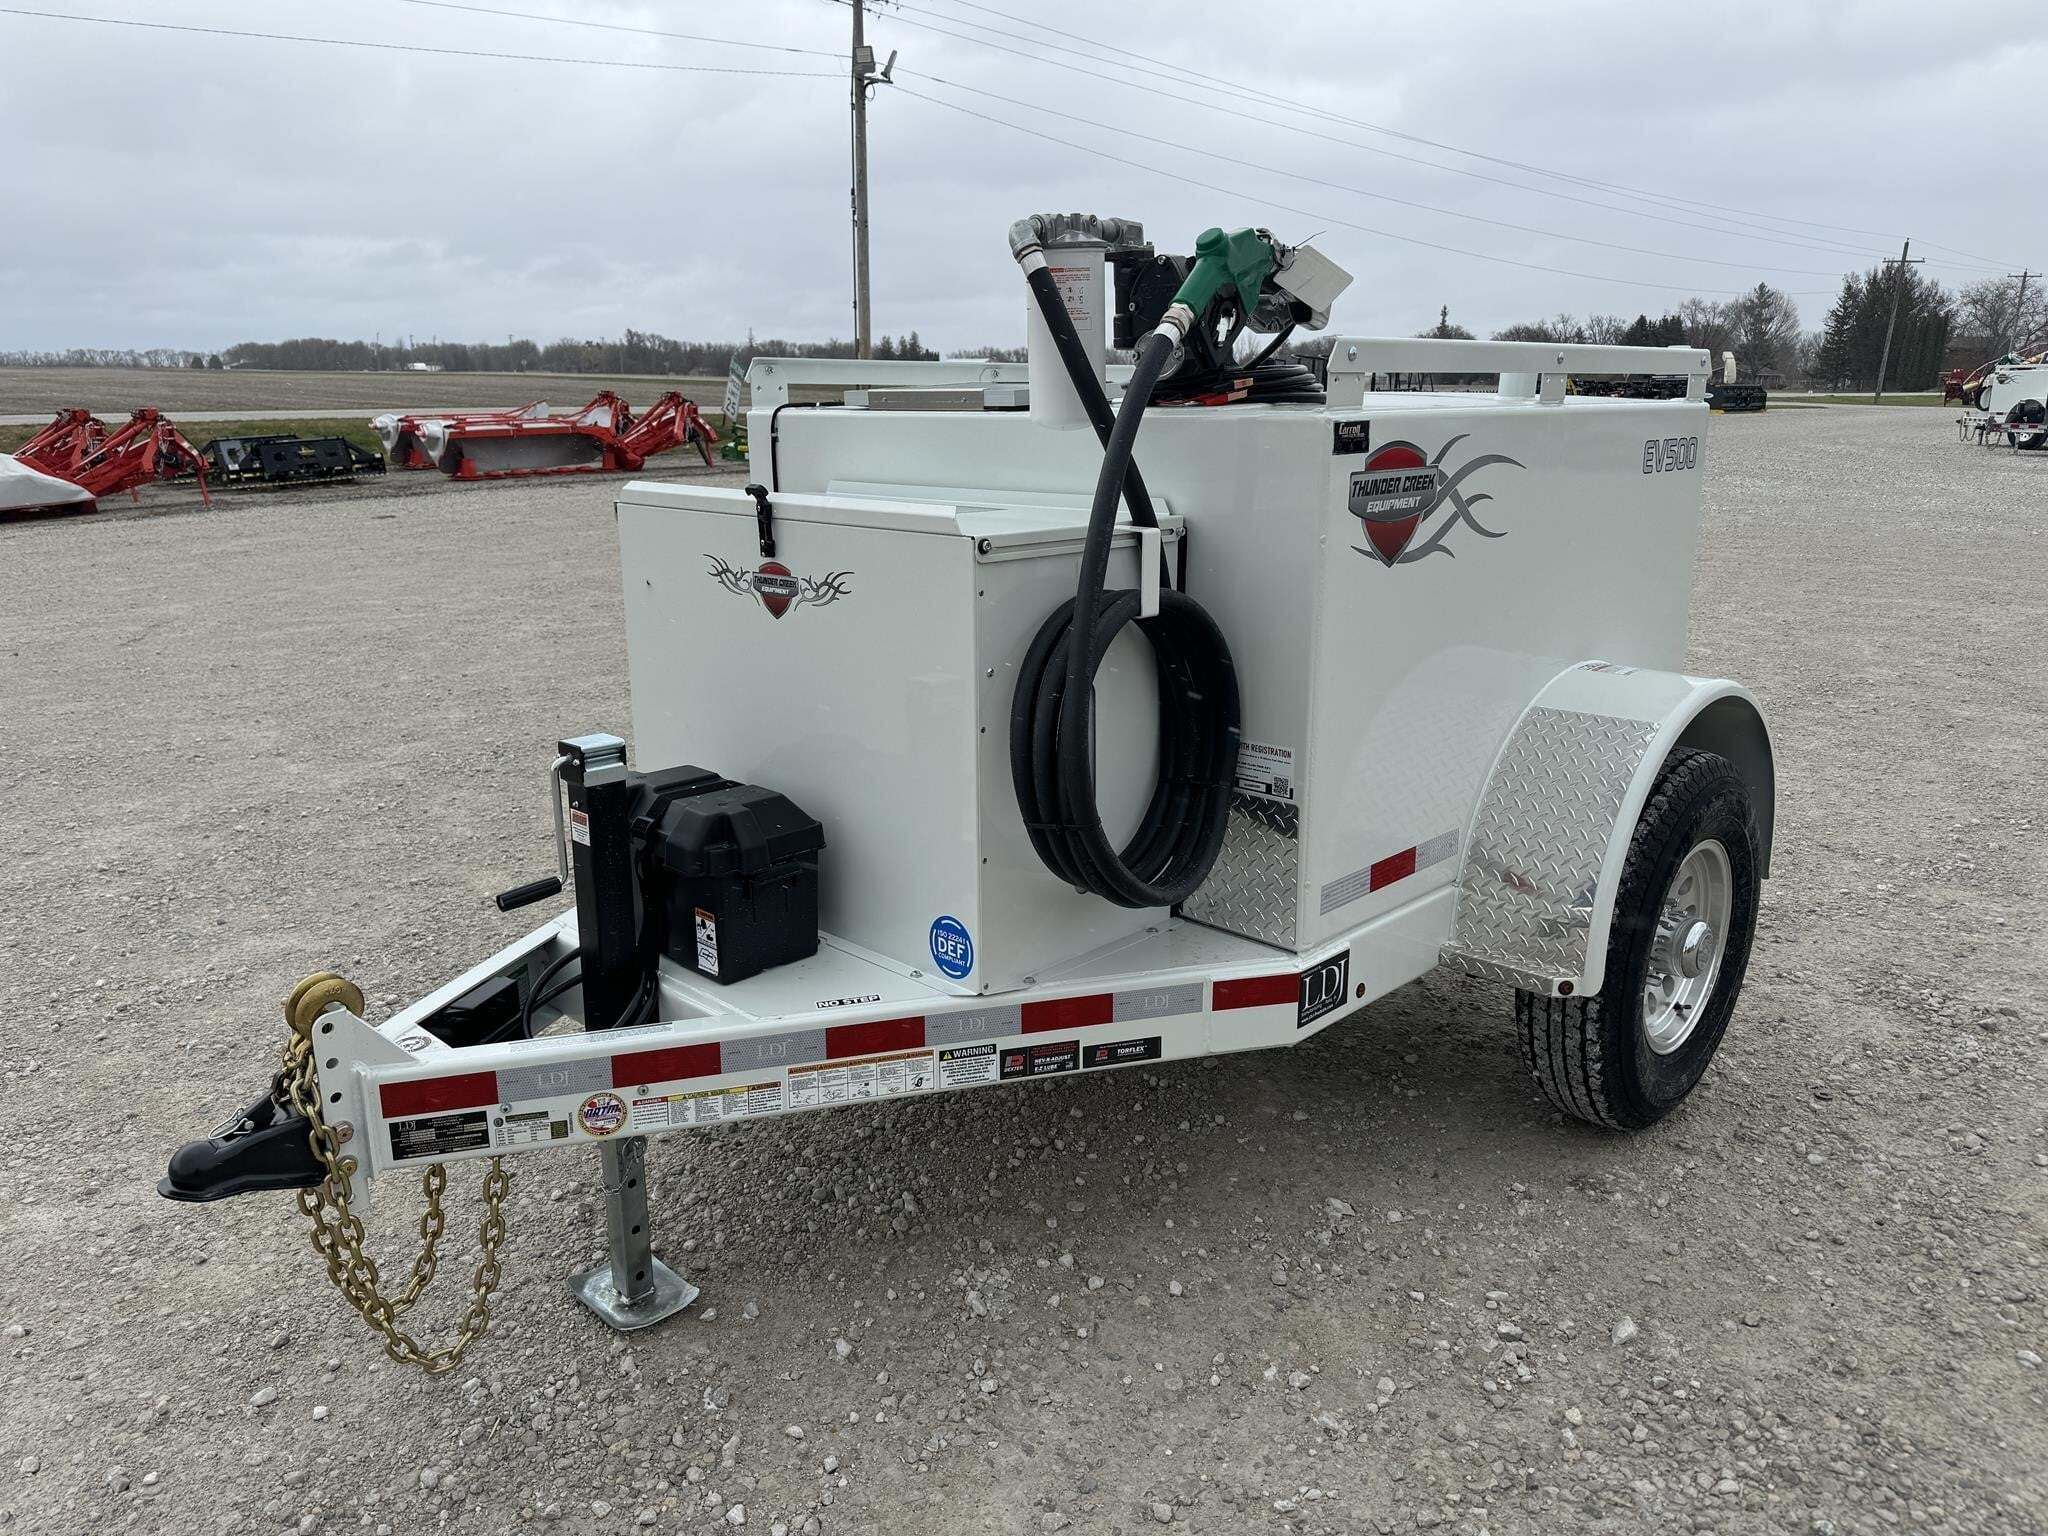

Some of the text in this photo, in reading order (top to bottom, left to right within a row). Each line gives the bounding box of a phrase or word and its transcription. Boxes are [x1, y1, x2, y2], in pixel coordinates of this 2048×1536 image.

[725, 398, 737, 416] 25
[1643, 437, 1698, 474] EV500
[1352, 474, 1436, 498] THUNDER CREEK
[1366, 496, 1422, 513] EQUIPMENT
[754, 575, 797, 589] THUNDER CREEK
[761, 585, 789, 595] EQUIPMENT
[1251, 744, 1292, 759] REGISTRATION
[937, 929, 966, 945] ISO 22241
[938, 936, 966, 959] DEF
[937, 952, 966, 967] COMPLIANT
[1302, 957, 1348, 1012] LDJ
[818, 995, 880, 1009] NO STEP
[1145, 994, 1170, 1008] LDJ
[958, 1016, 986, 1032] LDJ
[758, 1041, 787, 1057] LDJ
[953, 1046, 994, 1059] WARNING
[1117, 1045, 1145, 1055] TORFLEX
[537, 1071, 569, 1087] LDJ
[398, 1120, 416, 1131] LDJ
